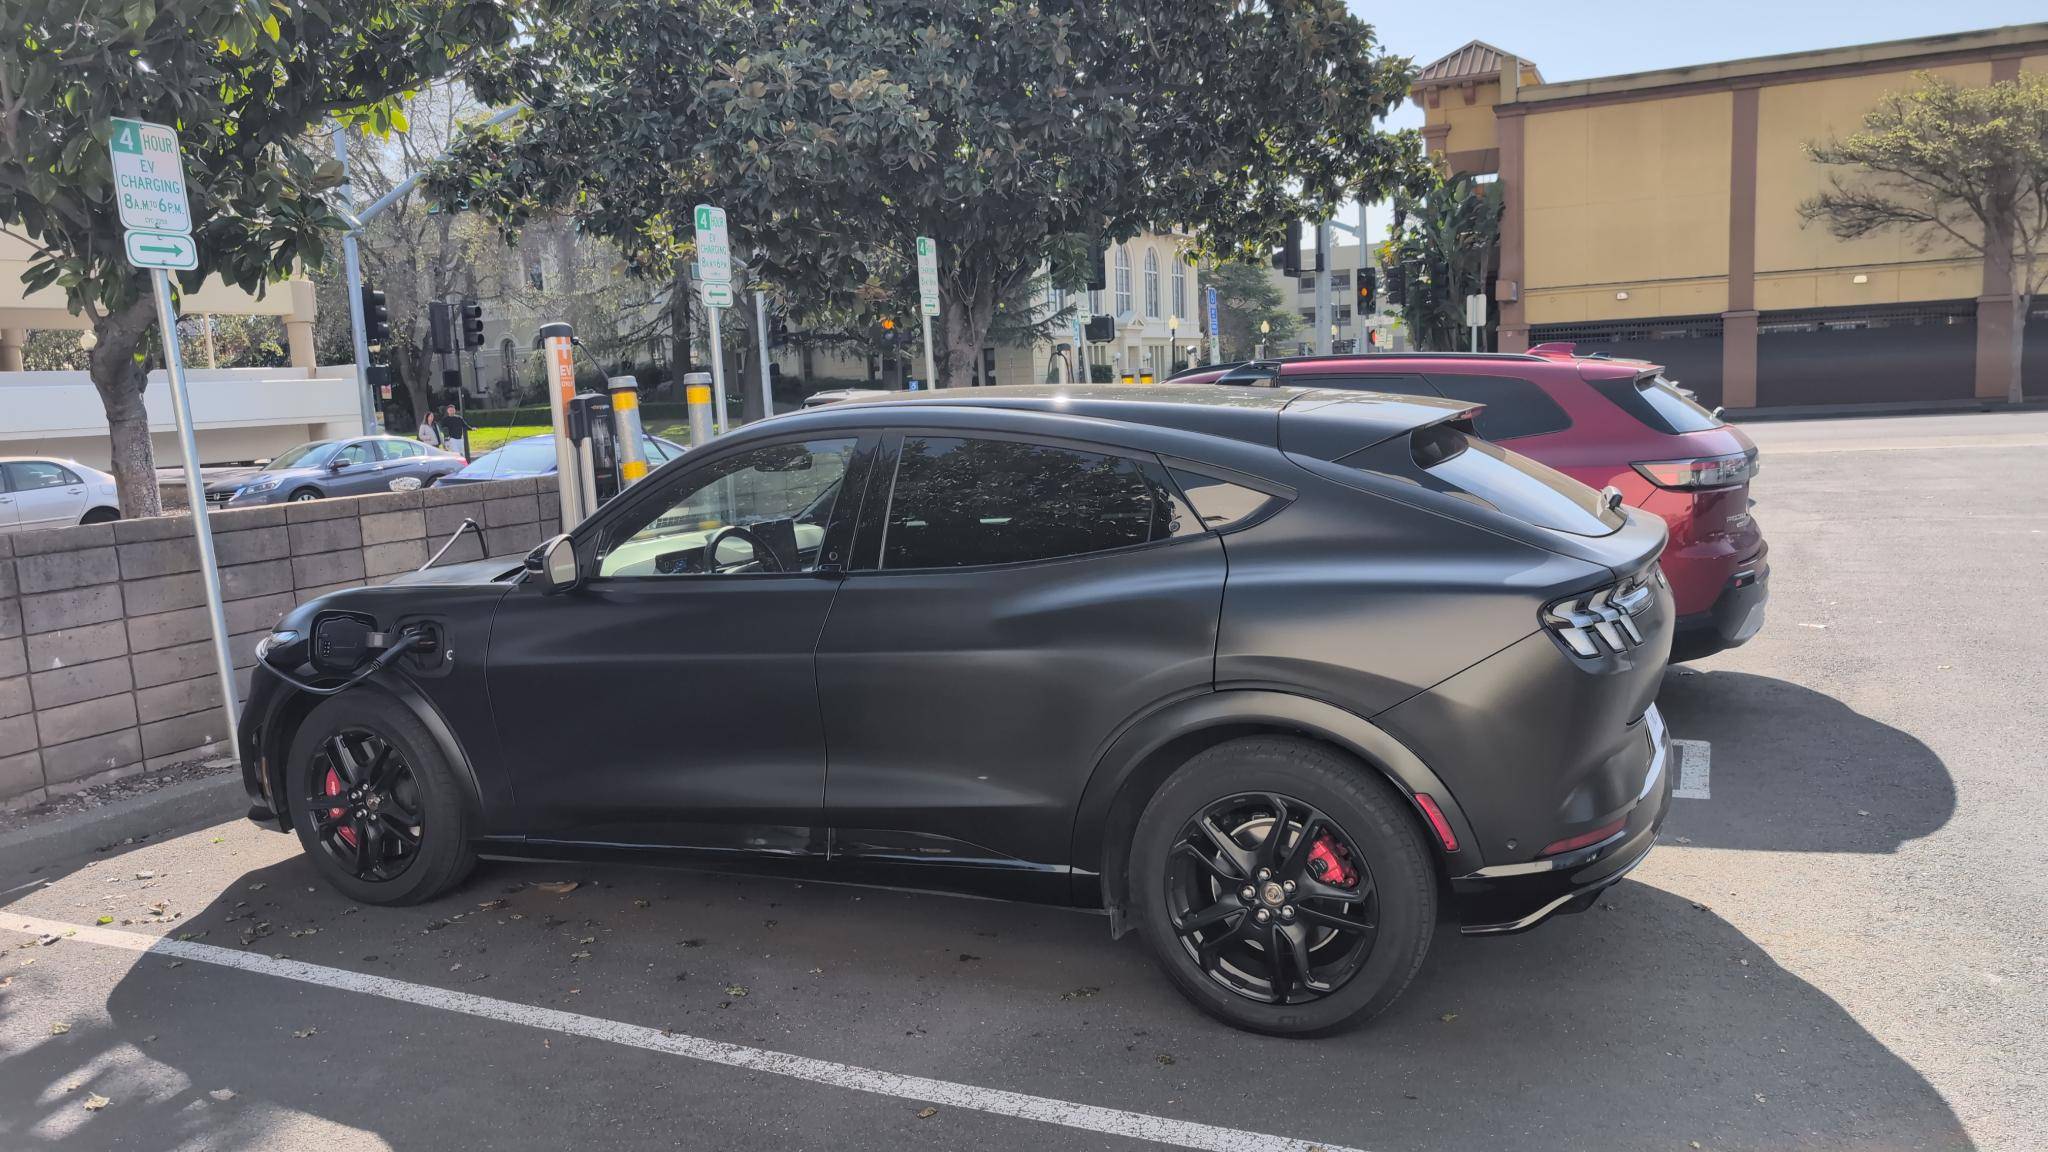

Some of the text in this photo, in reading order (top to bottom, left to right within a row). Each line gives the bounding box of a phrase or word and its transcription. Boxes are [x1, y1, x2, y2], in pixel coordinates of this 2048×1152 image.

[120, 128, 173, 153] 4 HOUR
[140, 159, 155, 173] EV
[121, 174, 180, 194] CHARGING
[700, 212, 707, 228] 4
